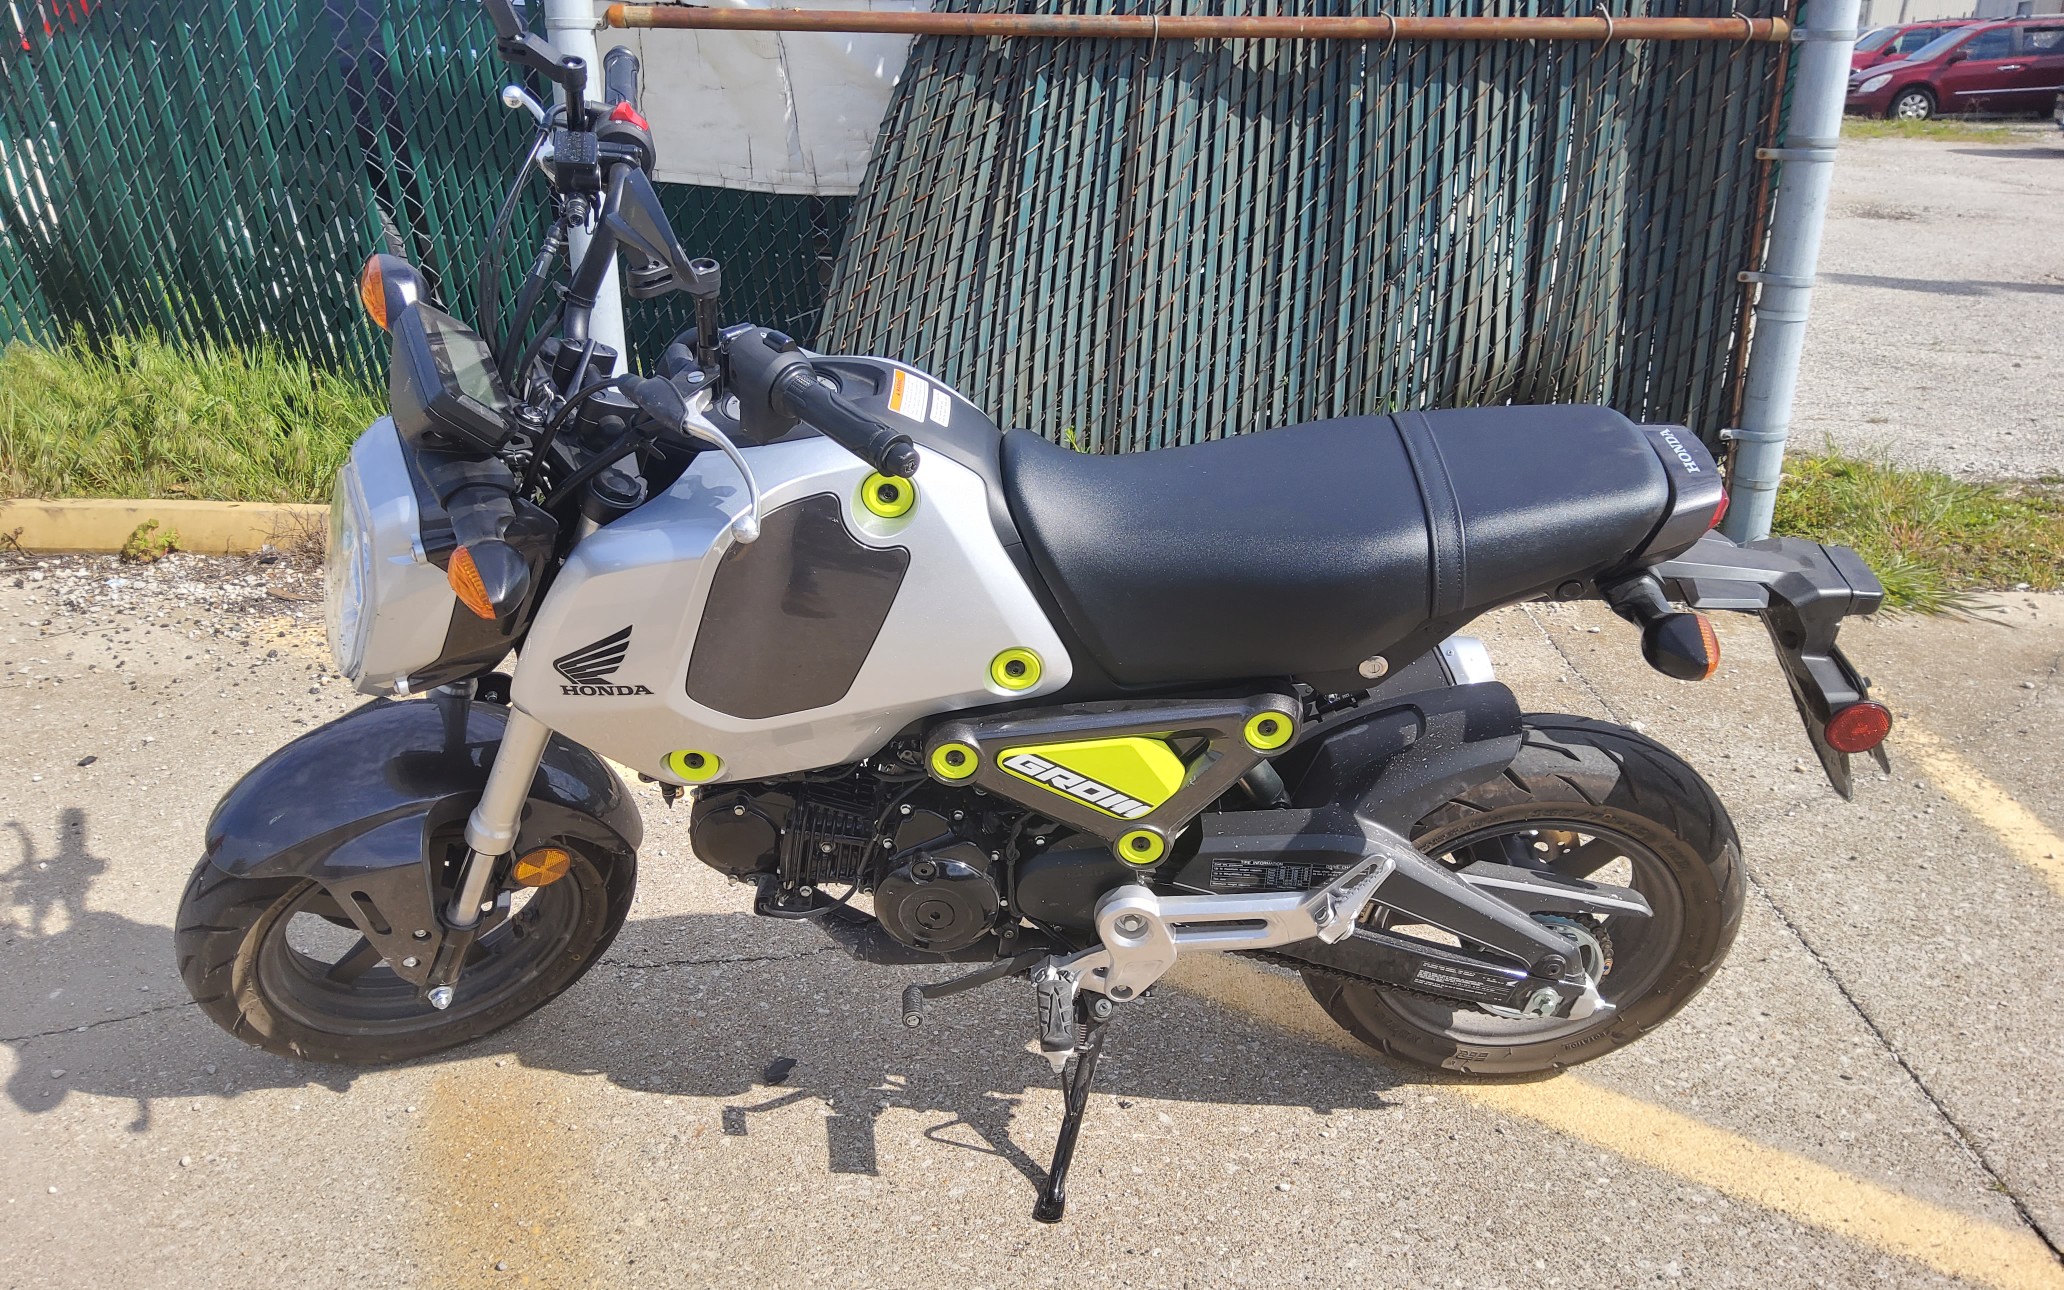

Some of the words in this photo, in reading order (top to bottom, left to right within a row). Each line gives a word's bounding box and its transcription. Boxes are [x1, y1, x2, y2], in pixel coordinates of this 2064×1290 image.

[1659, 428, 1701, 474] HONDA
[560, 685, 654, 696] HONDA
[1003, 753, 1153, 819] GROM
